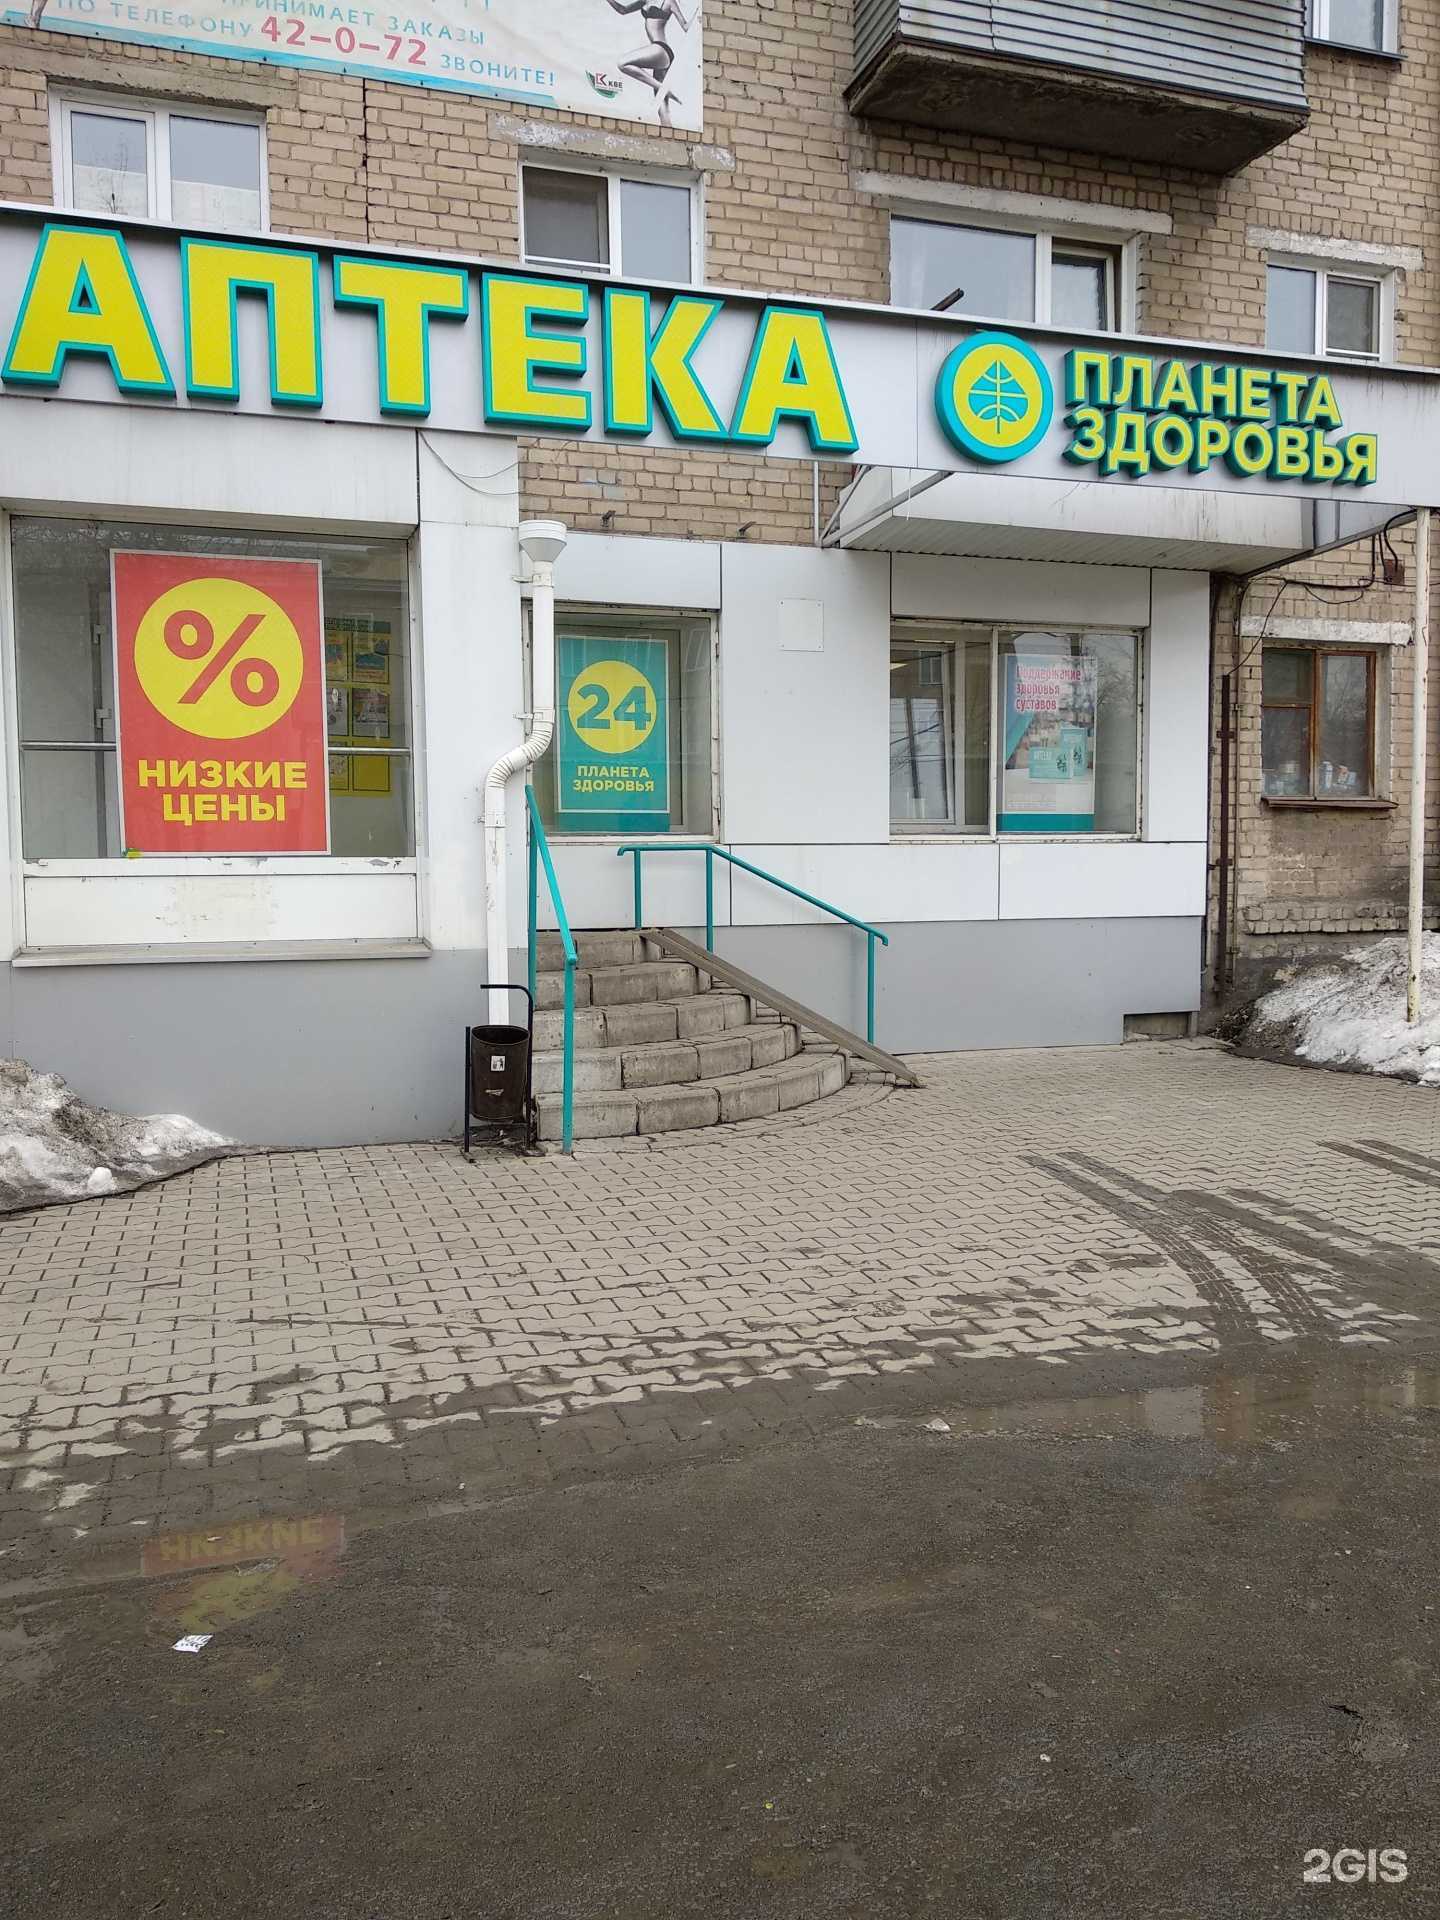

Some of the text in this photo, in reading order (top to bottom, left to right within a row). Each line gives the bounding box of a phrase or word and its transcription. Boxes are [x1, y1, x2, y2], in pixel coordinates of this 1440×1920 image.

[110, 2, 252, 37] ТЕЛЕФОНУ
[260, 16, 427, 66] 42-0-72
[440, 54, 554, 86] ЗВОНИТЕ!
[388, 16, 484, 45] ЗАКАЗЫ
[1, 223, 860, 454] АПТЕКА
[1065, 348, 1343, 429] ПЛАНЕТА
[1062, 405, 1379, 486] ЗДОРОВЬЯ
[163, 609, 280, 707] %
[1016, 683, 1060, 697] здоровья
[1016, 699, 1057, 712] суставов
[576, 683, 652, 731] 24
[137, 759, 308, 789] НИЗКИЕ
[572, 779, 655, 792] ЗДОРОВЬЯ
[576, 765, 650, 778] ПЛАНЕТА
[162, 793, 286, 826] ЦЕНЫ
